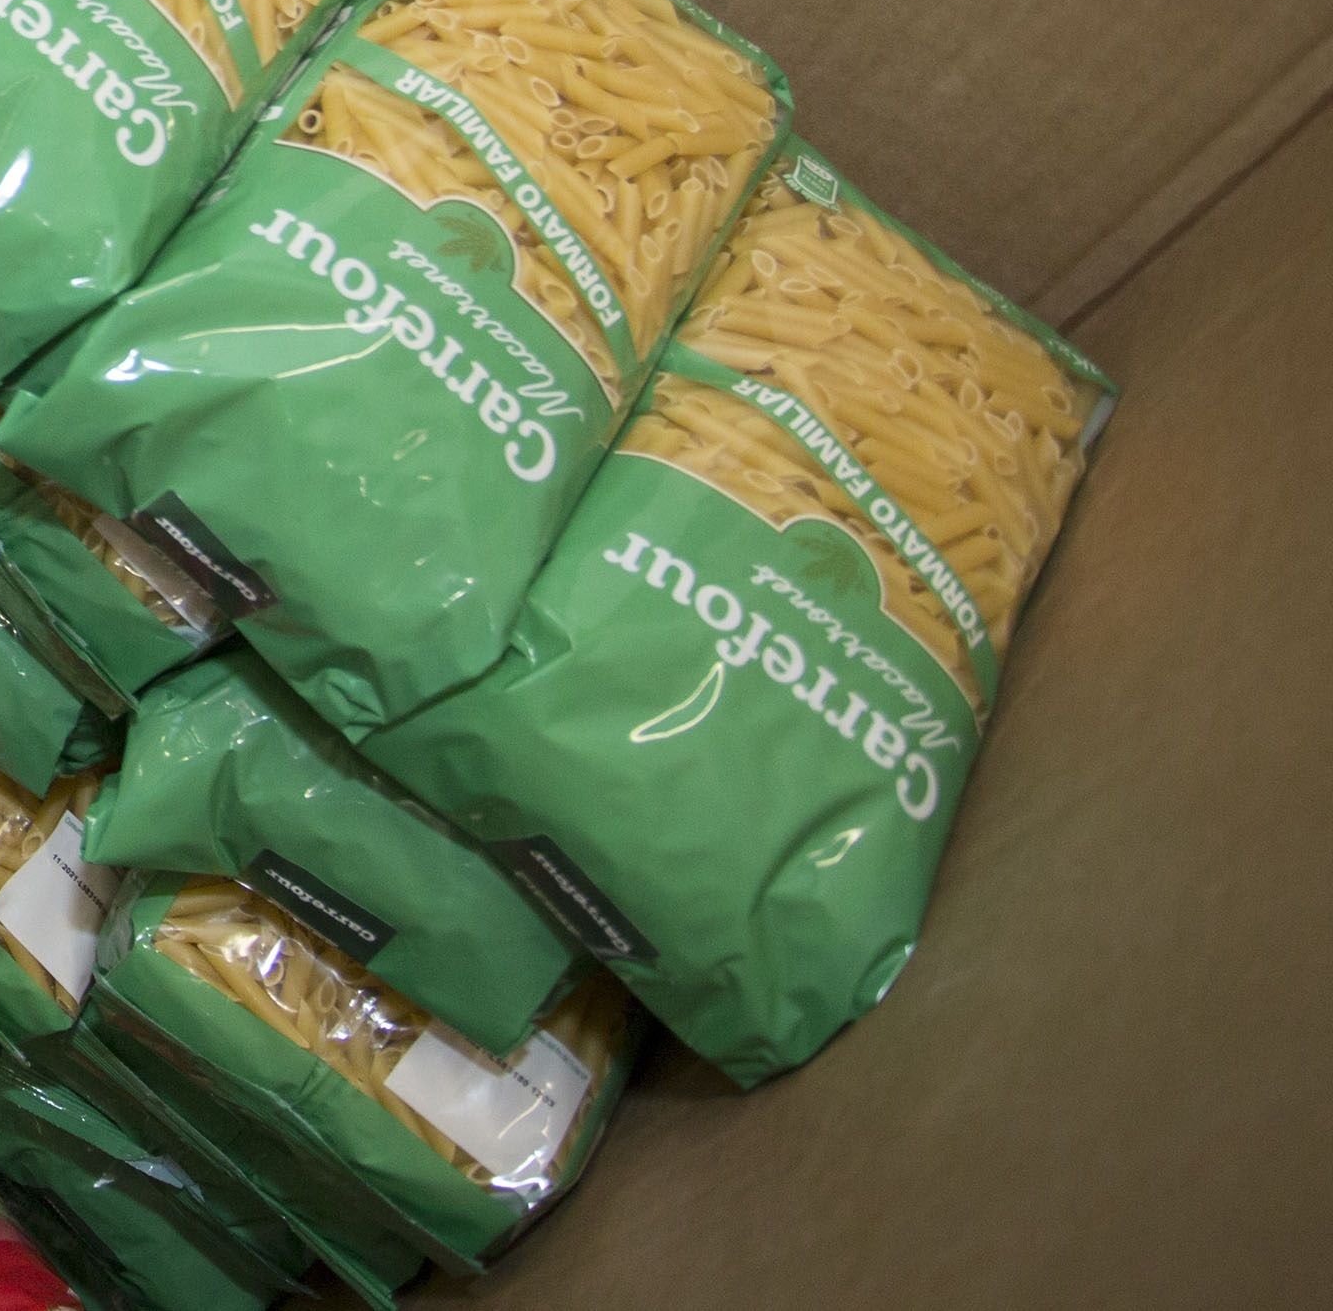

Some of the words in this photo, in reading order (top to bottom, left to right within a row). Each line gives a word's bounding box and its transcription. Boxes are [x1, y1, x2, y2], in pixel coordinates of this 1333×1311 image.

[394, 67, 527, 185] FAMILIAR
[515, 184, 625, 328] FORMATO
[250, 208, 556, 481] Carrefour
[388, 239, 585, 422] Macarrones
[732, 378, 881, 497] FAMILIAR
[154, 515, 259, 605] Carrefour
[869, 497, 984, 649] FORMATO
[602, 532, 938, 821] Carrefour
[751, 562, 961, 754] Macarrones
[263, 864, 376, 946] Carrefour
